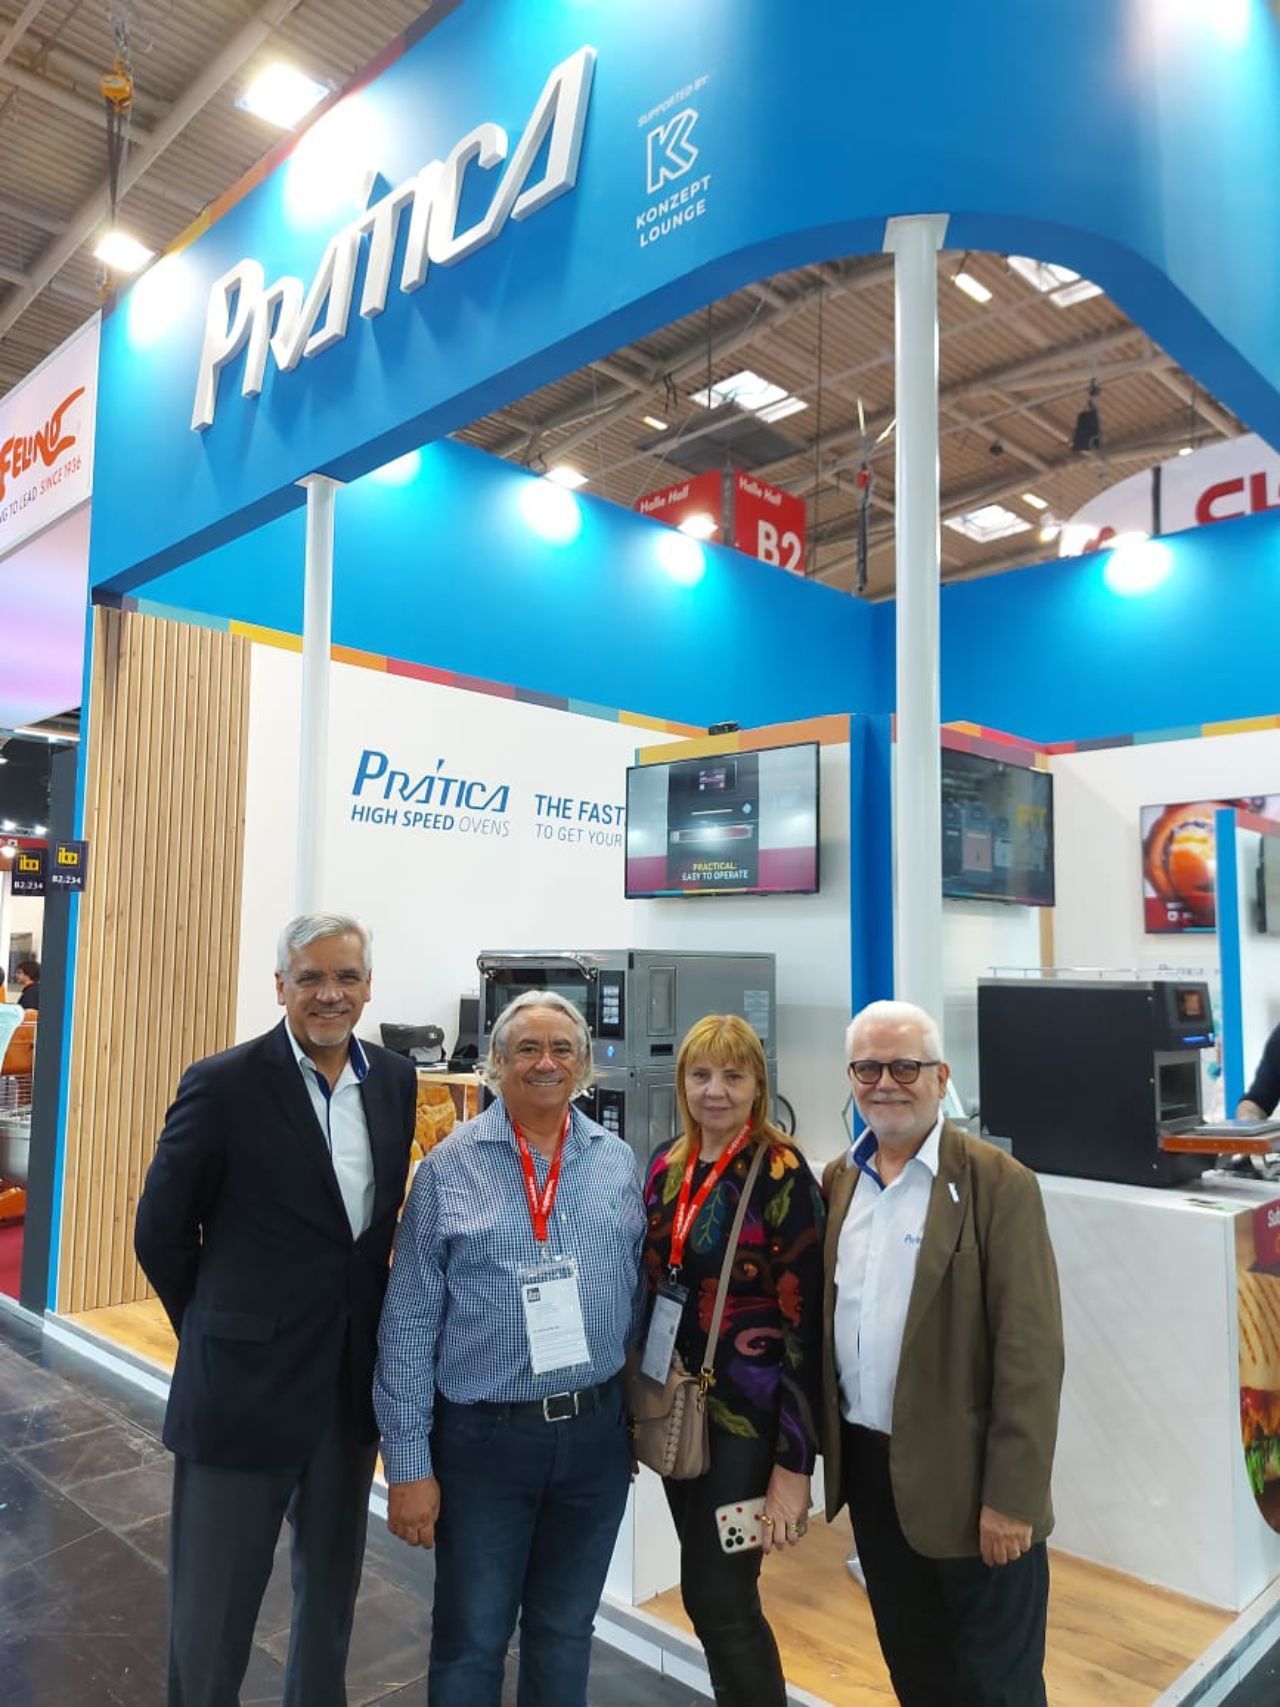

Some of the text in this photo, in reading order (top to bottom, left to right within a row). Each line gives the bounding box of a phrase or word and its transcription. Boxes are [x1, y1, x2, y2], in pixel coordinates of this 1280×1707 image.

[647, 107, 699, 195] K
[635, 174, 712, 230] KONZEPT
[640, 198, 707, 248] LOUNGE
[20, 486, 38, 510] LEAD
[40, 467, 62, 495] SINCE
[640, 485, 690, 514] Halle Hall
[739, 476, 782, 507] Halle Hall
[758, 519, 806, 577] B2
[351, 804, 510, 838] HIGH SPEED OVENS
[535, 794, 626, 826] THE FAST
[535, 823, 623, 847] TO GET YOUR
[682, 869, 749, 881] EASY TO OPERATE
